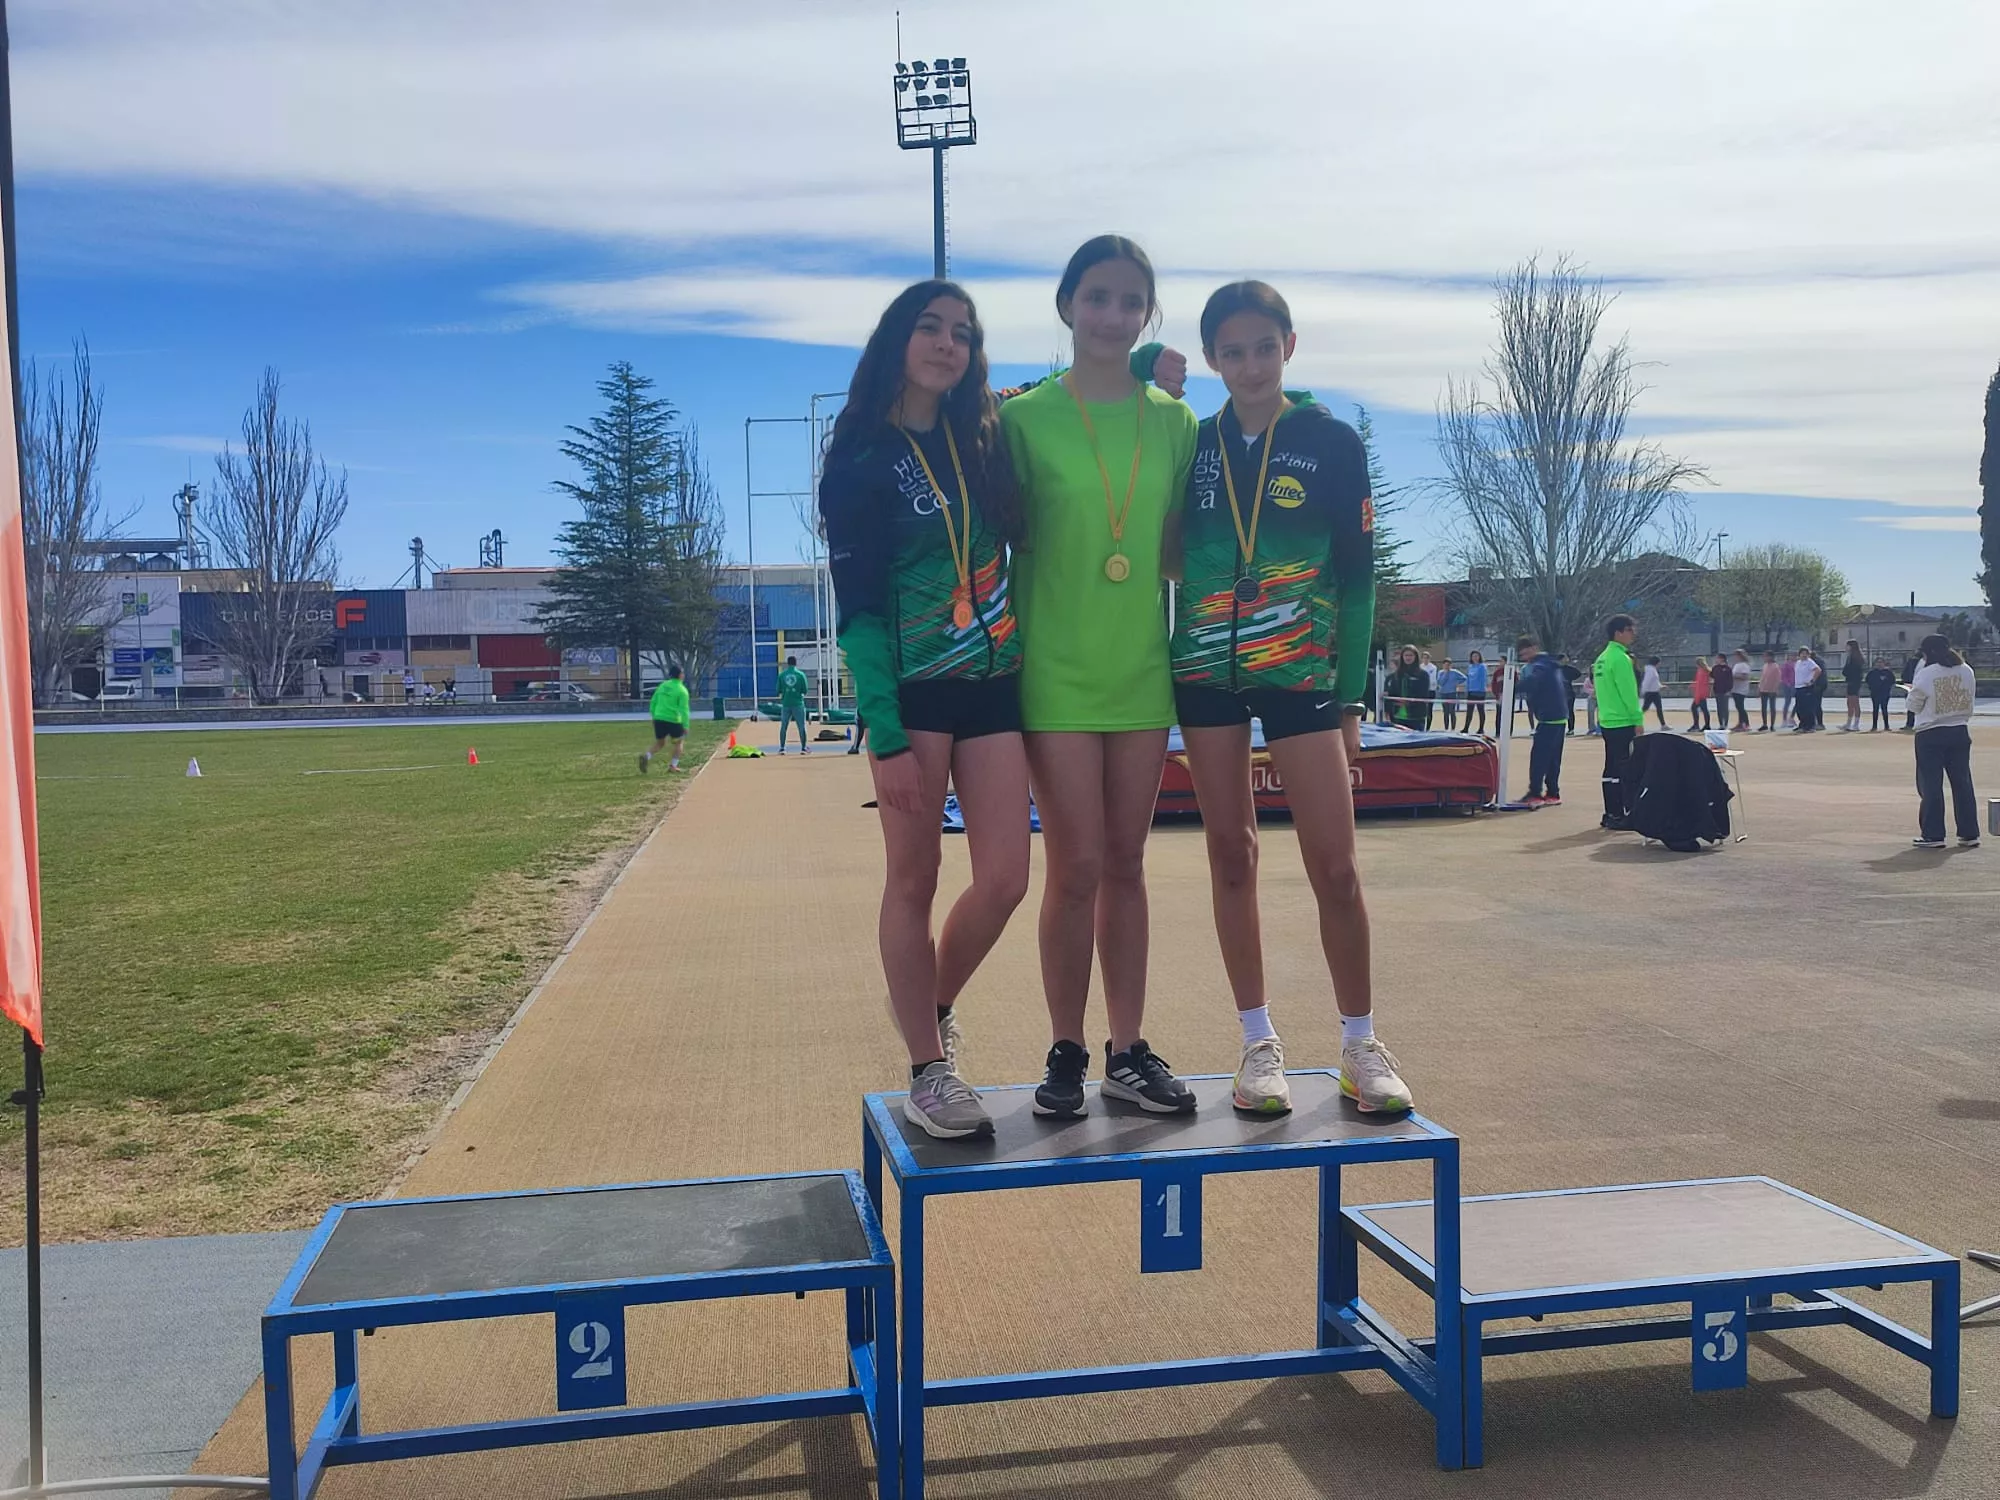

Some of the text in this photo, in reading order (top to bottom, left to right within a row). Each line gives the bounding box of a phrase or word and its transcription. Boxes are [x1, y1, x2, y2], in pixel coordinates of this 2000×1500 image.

[1156, 1183, 1184, 1238] 1
[568, 1321, 613, 1381] 2
[1702, 1310, 1739, 1362] 3
